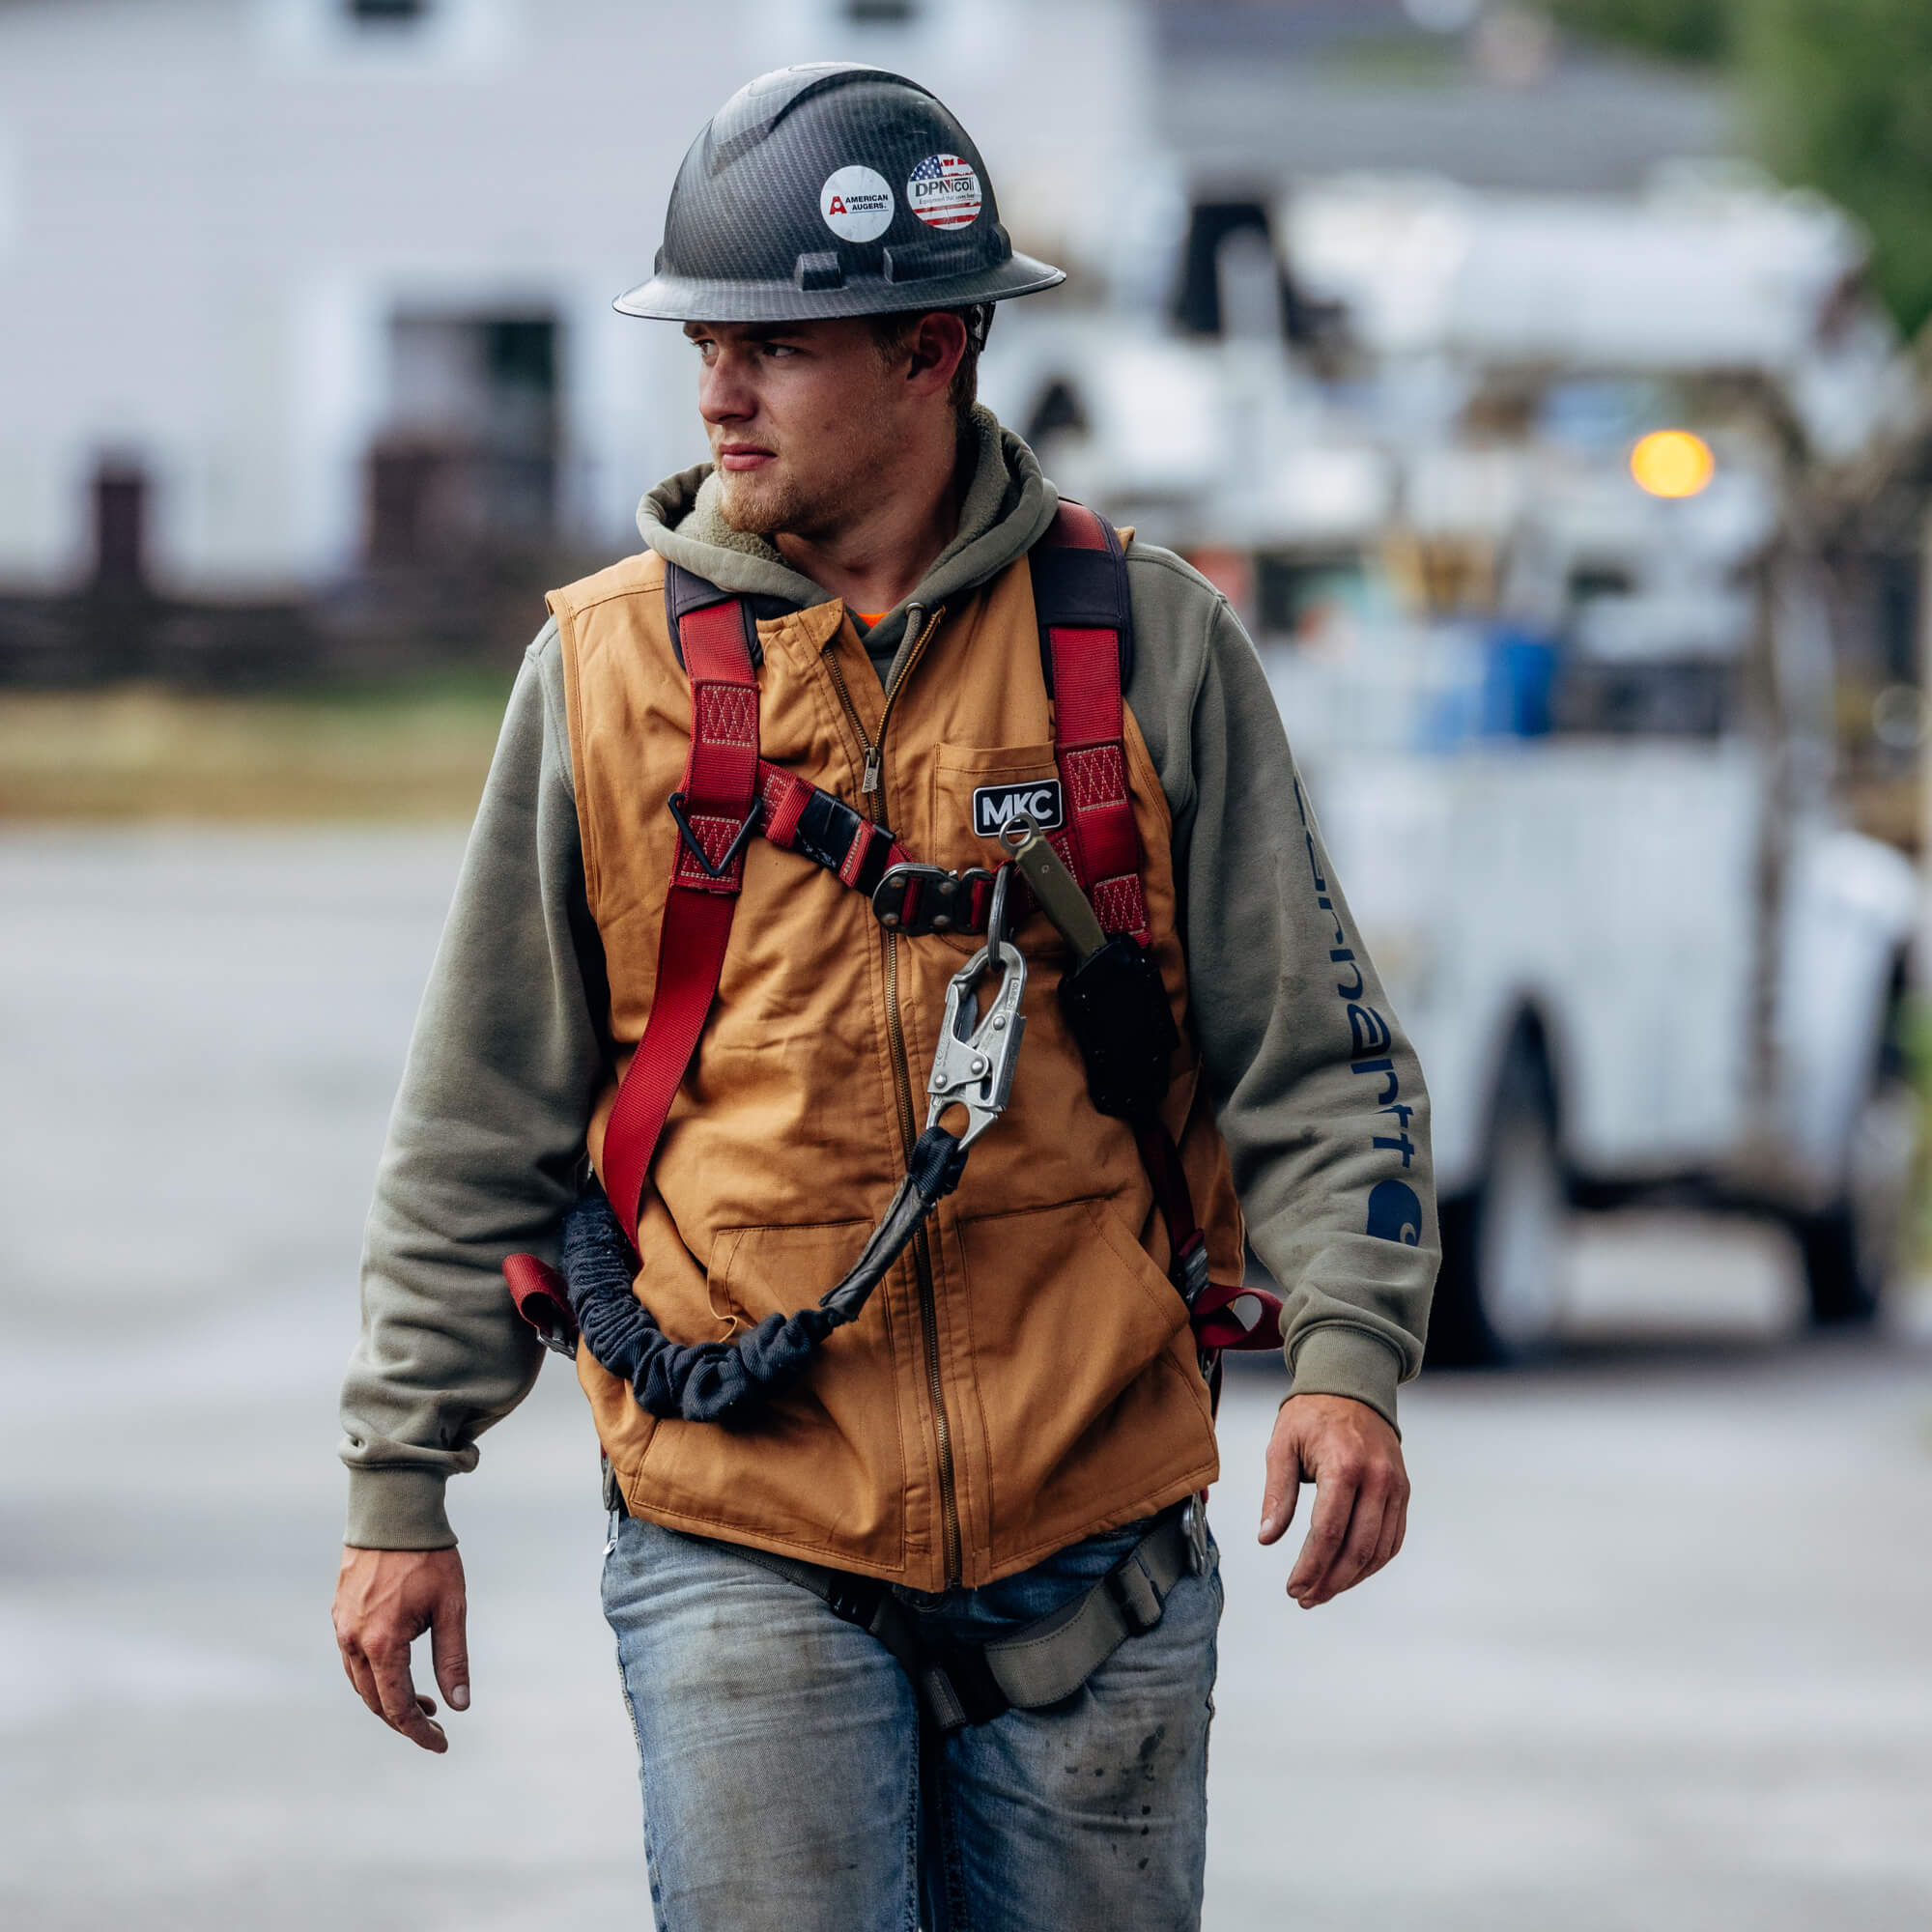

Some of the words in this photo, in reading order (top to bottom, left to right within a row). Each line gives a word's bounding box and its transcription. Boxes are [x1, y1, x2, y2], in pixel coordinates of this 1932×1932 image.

[845, 194, 889, 204] AMERICAN
[852, 202, 884, 211] AUGERS
[981, 789, 1053, 826] MKC
